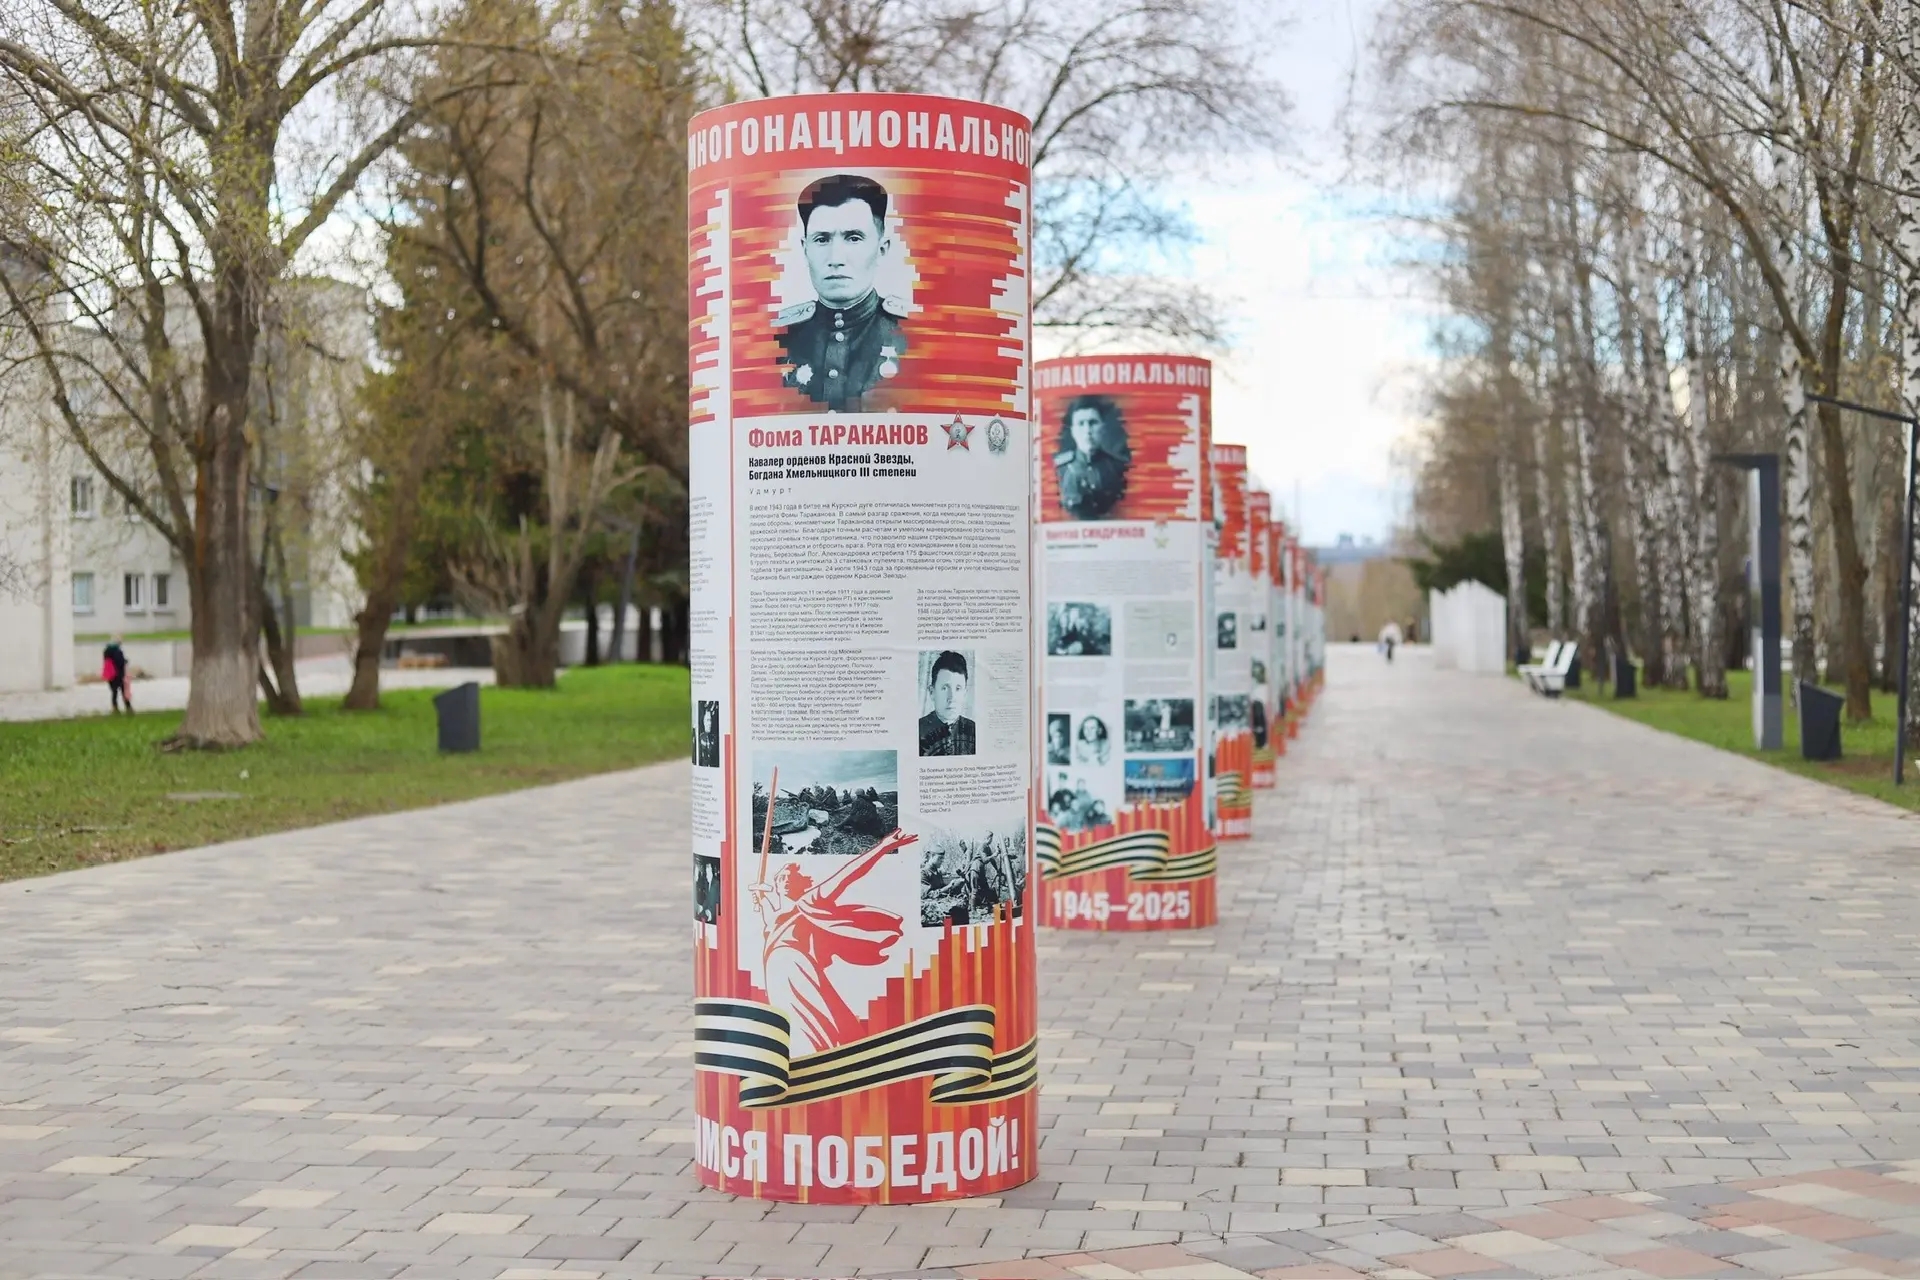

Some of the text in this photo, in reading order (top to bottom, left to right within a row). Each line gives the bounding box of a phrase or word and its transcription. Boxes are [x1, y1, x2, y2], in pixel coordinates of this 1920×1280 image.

[749, 424, 929, 448] Фома ТАРАКАНОВ
[749, 453, 914, 468] Кавалер орденов Красной Звезды,
[749, 467, 917, 481] Богдана Хмельницкого III степени
[837, 518, 874, 526] Тараканова
[802, 526, 835, 535] Благодаря
[813, 542, 844, 550] отбросить
[822, 550, 870, 558] Александровка
[783, 1116, 1020, 1194] ПОБЕДОЙ!
